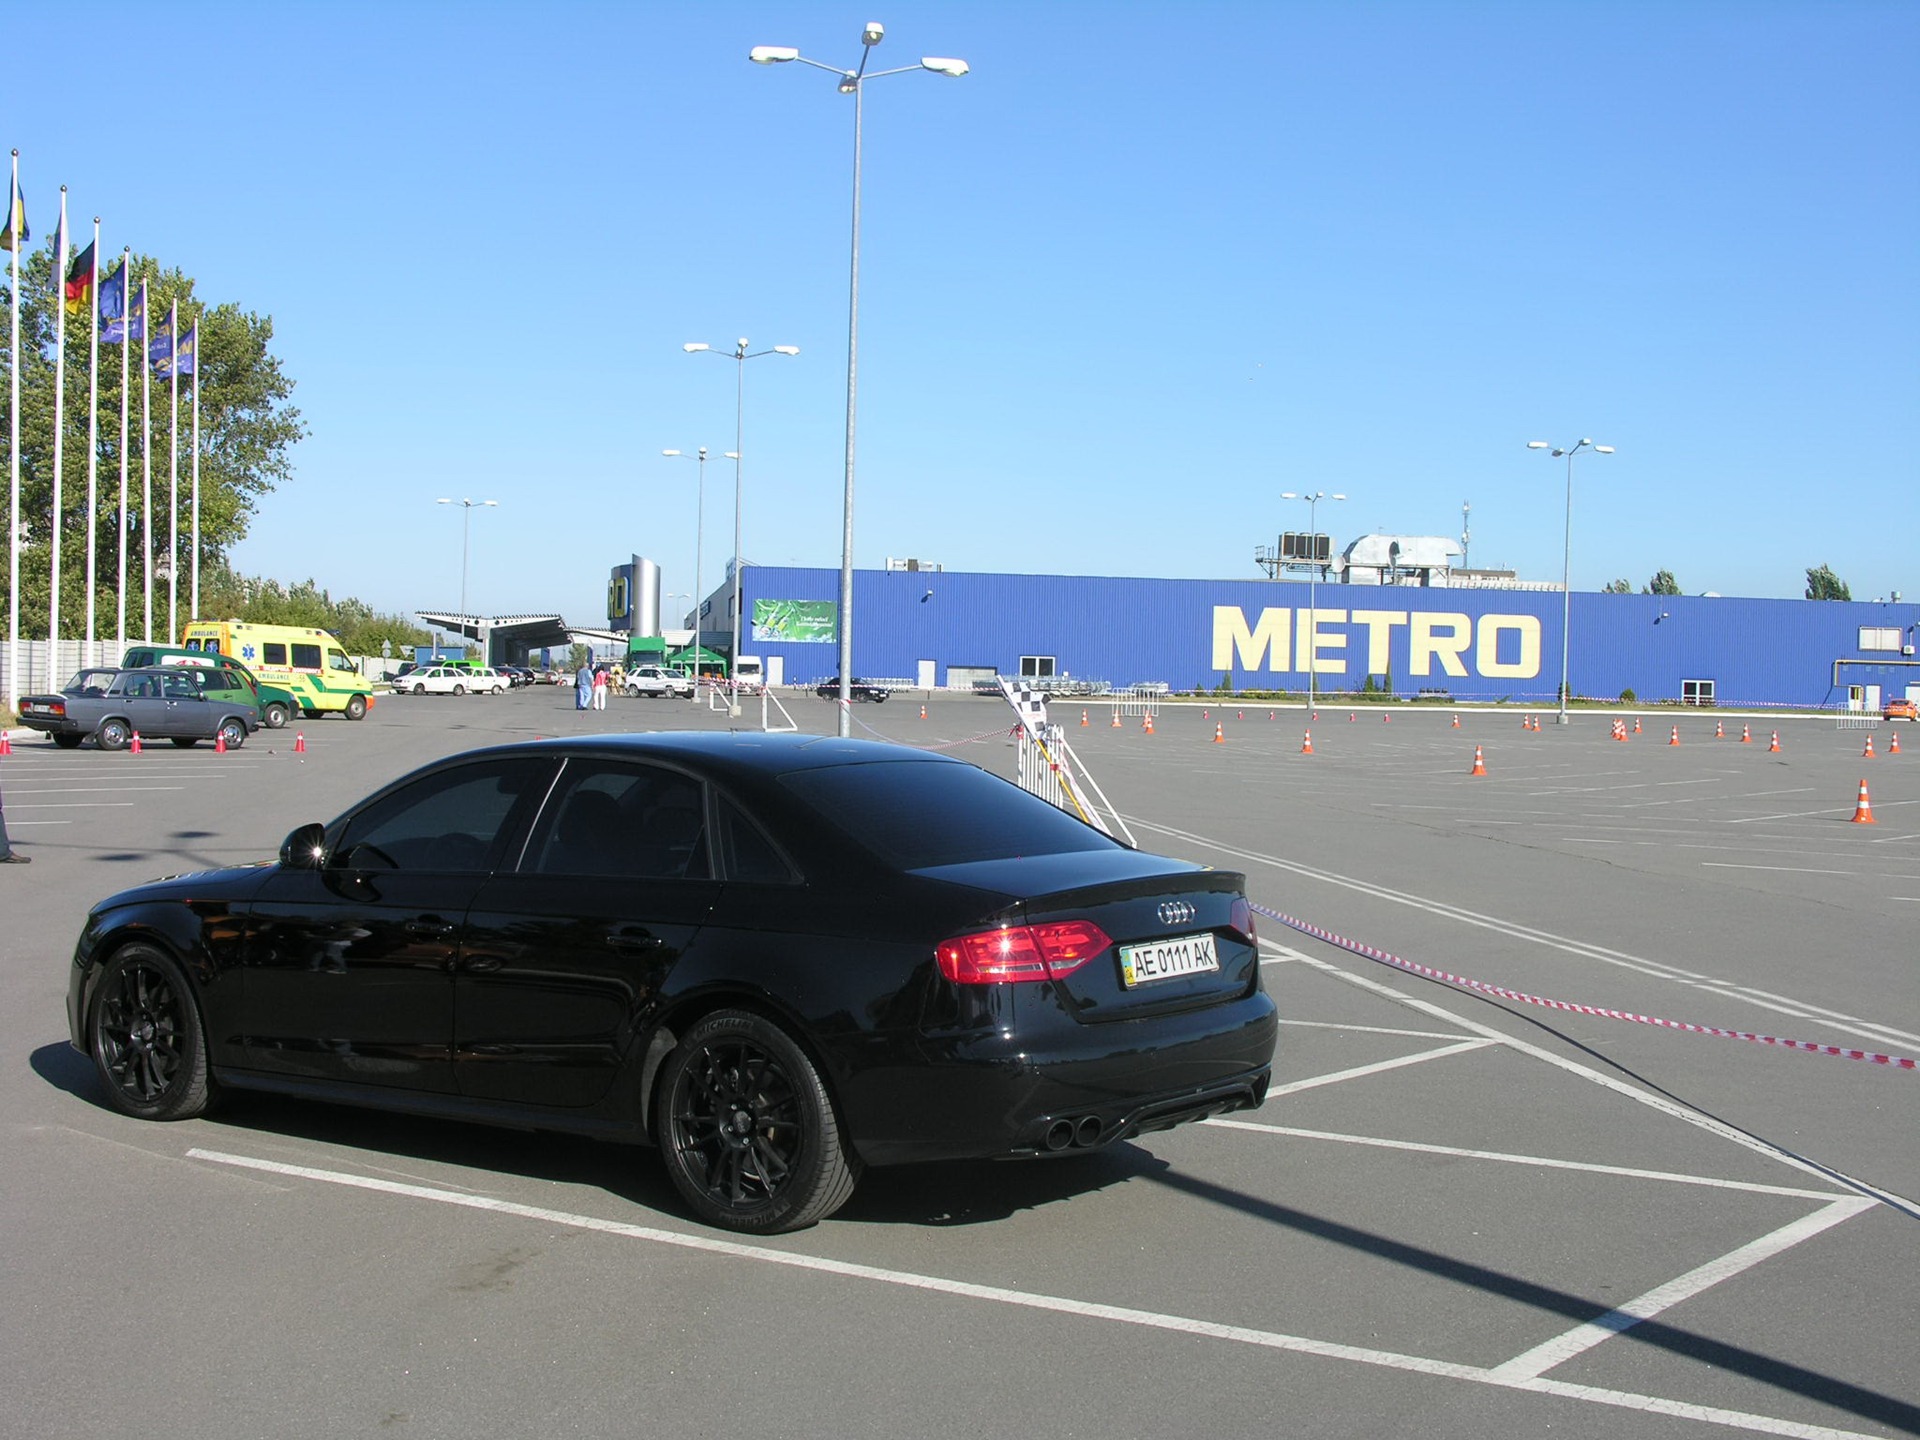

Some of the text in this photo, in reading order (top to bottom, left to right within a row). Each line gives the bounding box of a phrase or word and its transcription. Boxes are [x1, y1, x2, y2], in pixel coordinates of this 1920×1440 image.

[1212, 605, 1541, 679] METRO
[258, 673, 289, 681] AMBULANCE
[1135, 950, 1157, 977] AE
[1157, 944, 1192, 973] 0111
[1194, 940, 1214, 967] AK
[695, 1018, 754, 1038] MICHELIN
